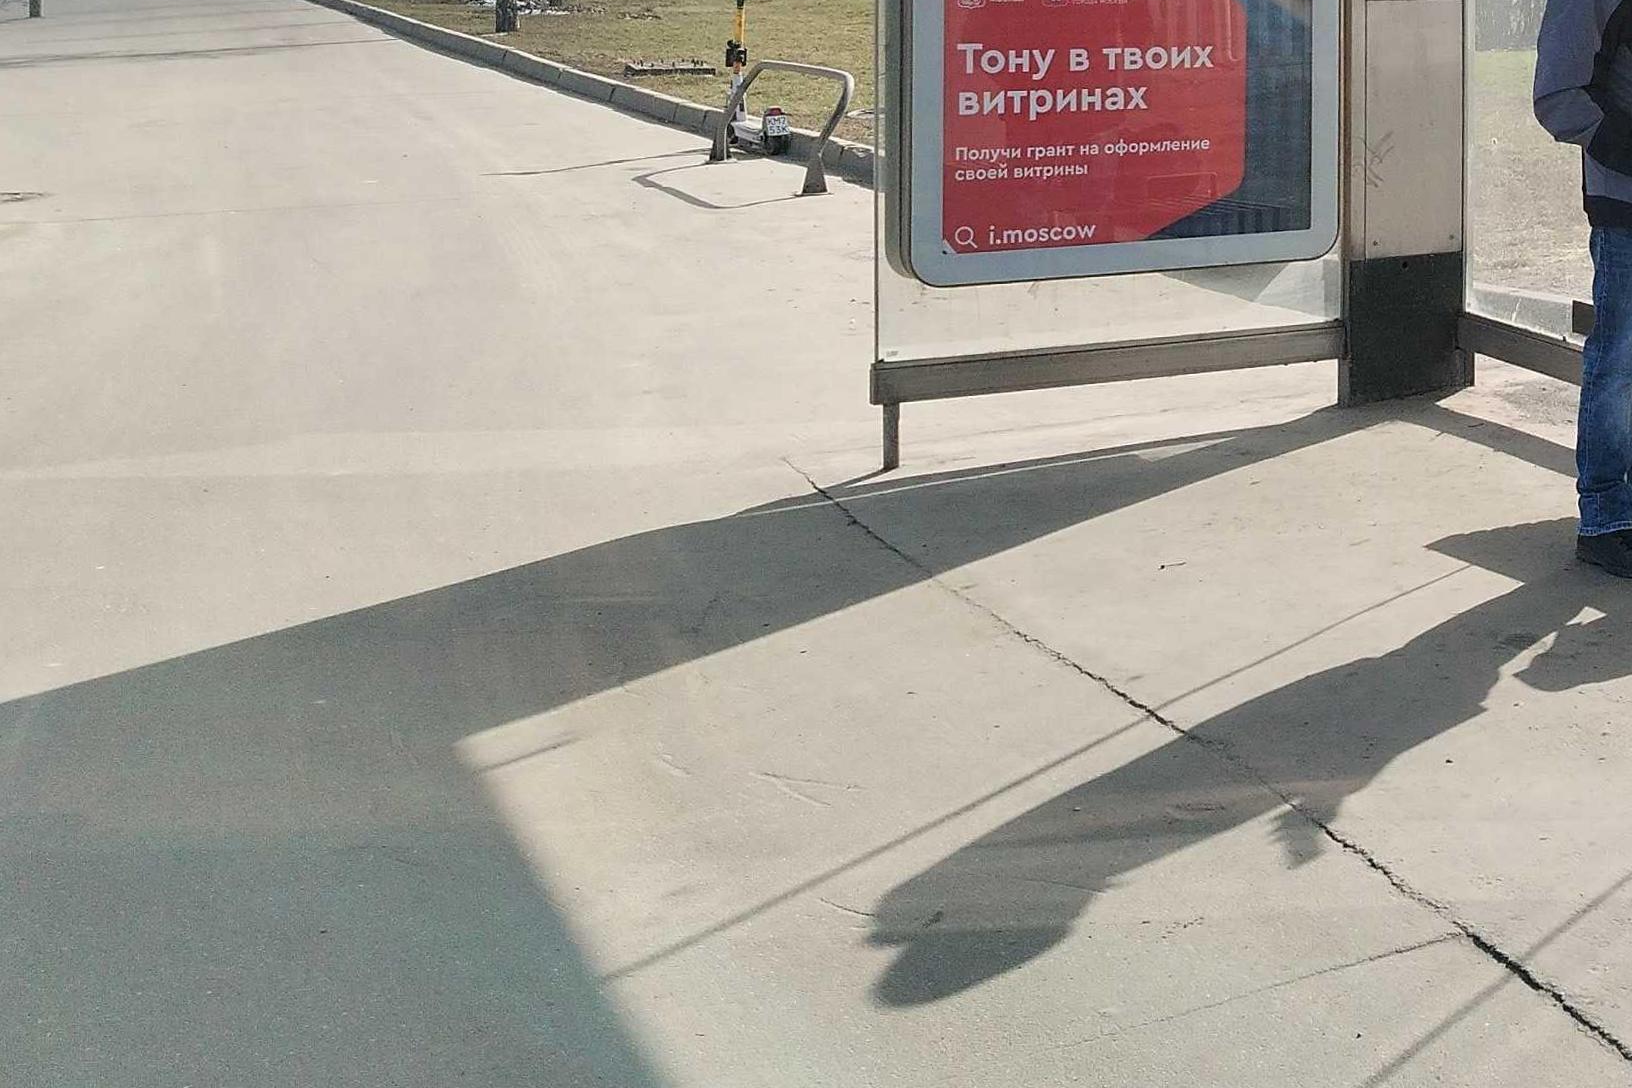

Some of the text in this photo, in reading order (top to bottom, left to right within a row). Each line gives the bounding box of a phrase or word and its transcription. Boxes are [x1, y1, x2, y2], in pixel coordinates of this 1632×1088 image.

[957, 43, 1214, 80] Тону в твоих
[958, 87, 1148, 120] витринах
[955, 138, 1210, 162] Получи грант на оформление
[955, 163, 1088, 181] своей витрины
[988, 224, 1096, 245] i.moscow
